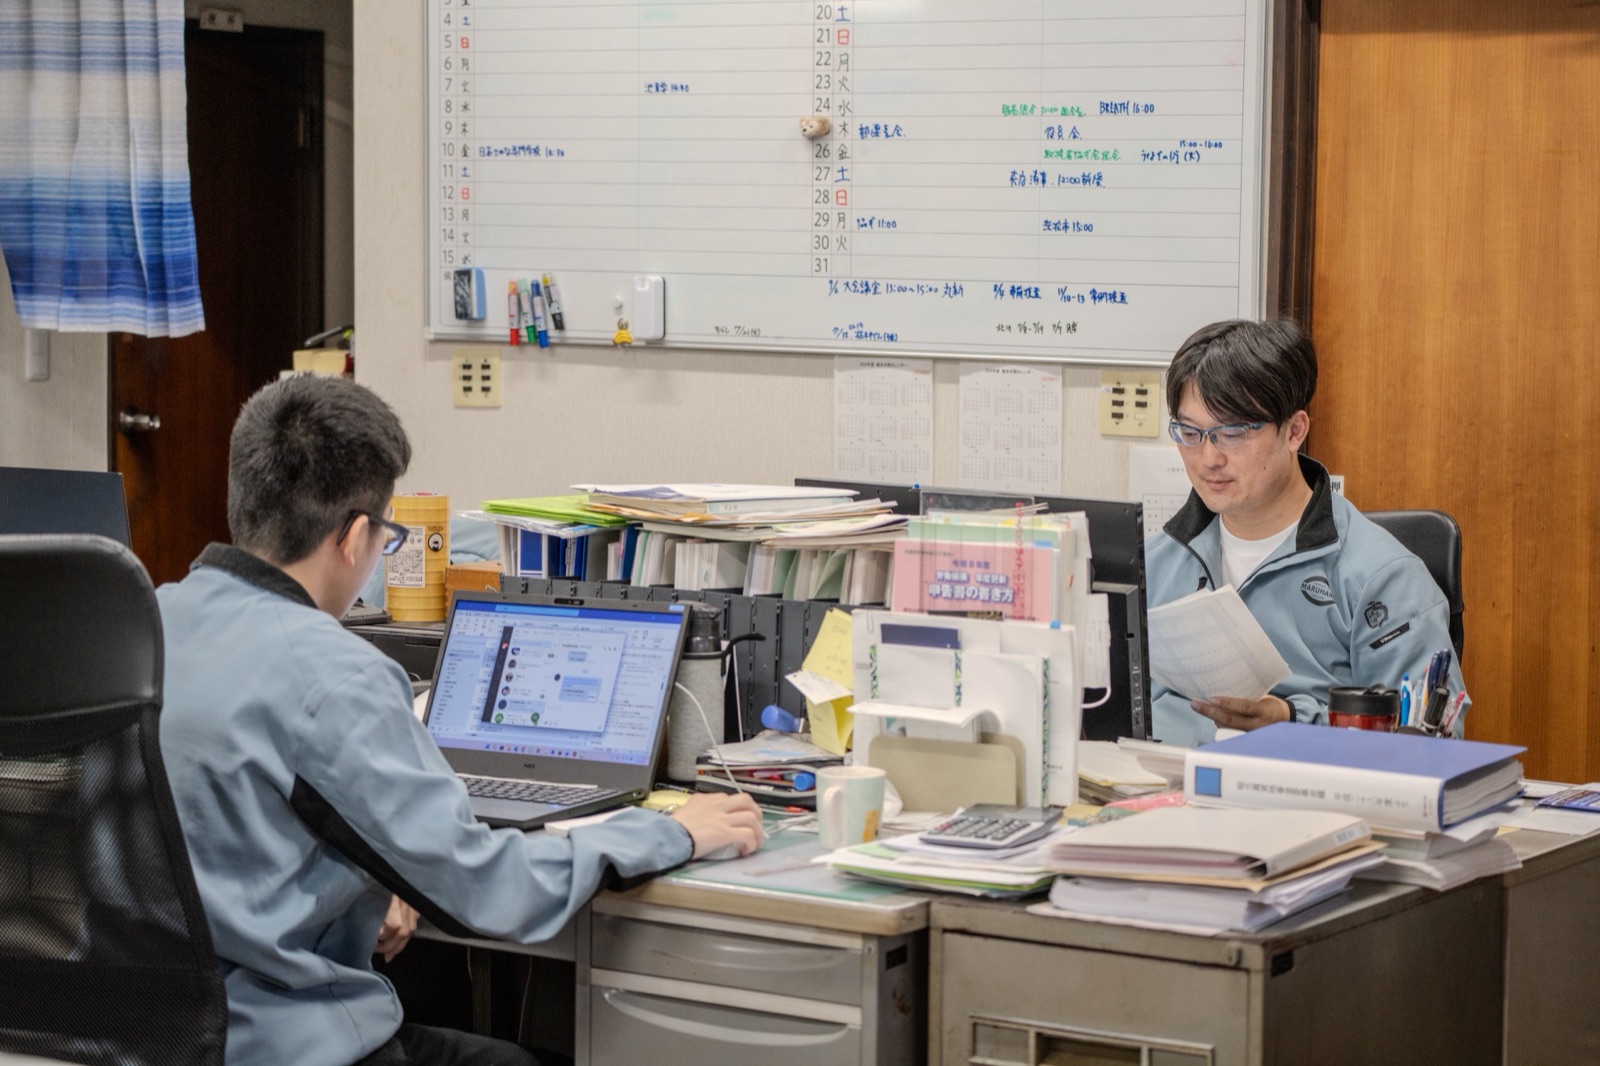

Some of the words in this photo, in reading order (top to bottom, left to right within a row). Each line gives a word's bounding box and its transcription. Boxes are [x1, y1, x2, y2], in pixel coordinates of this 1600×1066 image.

[443, 13, 452, 26] 4
[462, 17, 471, 26] 土
[816, 5, 832, 20] 20
[836, 6, 850, 22] 土
[444, 35, 452, 49] 5
[459, 37, 470, 50] 日
[817, 28, 829, 43] 21
[837, 29, 850, 45] 日
[444, 57, 452, 71] 6
[461, 58, 470, 72] 月
[816, 51, 831, 66] 22
[838, 53, 849, 72] 月
[445, 78, 453, 92] 7
[461, 81, 469, 93] 火
[816, 74, 830, 89] 23
[839, 76, 850, 91] 火
[444, 100, 453, 114] 8
[461, 102, 471, 113] 水
[816, 98, 830, 112] 24
[839, 100, 852, 117] 水
[1100, 101, 1129, 116] BREATH
[1133, 102, 1155, 114] 16:00
[444, 121, 453, 135] 9
[460, 122, 469, 136] 木
[839, 121, 848, 137] 木
[442, 143, 455, 157] 10
[461, 144, 470, 158] 金
[815, 143, 830, 158] 26
[838, 144, 850, 160] 金
[442, 165, 453, 177] 11
[461, 167, 471, 178] 土
[815, 166, 830, 181] 27
[835, 166, 850, 183] 土
[442, 186, 454, 200] 12
[461, 188, 470, 201] 日
[815, 189, 829, 204] 28
[835, 189, 847, 206] 日
[442, 207, 454, 222] 13
[462, 209, 469, 222] 月
[814, 212, 829, 227] 29
[837, 212, 845, 229] 月
[1073, 220, 1094, 233] 15:00
[442, 229, 455, 241] 14
[462, 233, 470, 244] 火
[814, 235, 829, 250] 30
[837, 235, 847, 250] 火
[442, 250, 454, 264] 15
[461, 255, 471, 265] 水
[815, 258, 827, 272] 31
[928, 583, 1014, 604] 申告書の書き方
